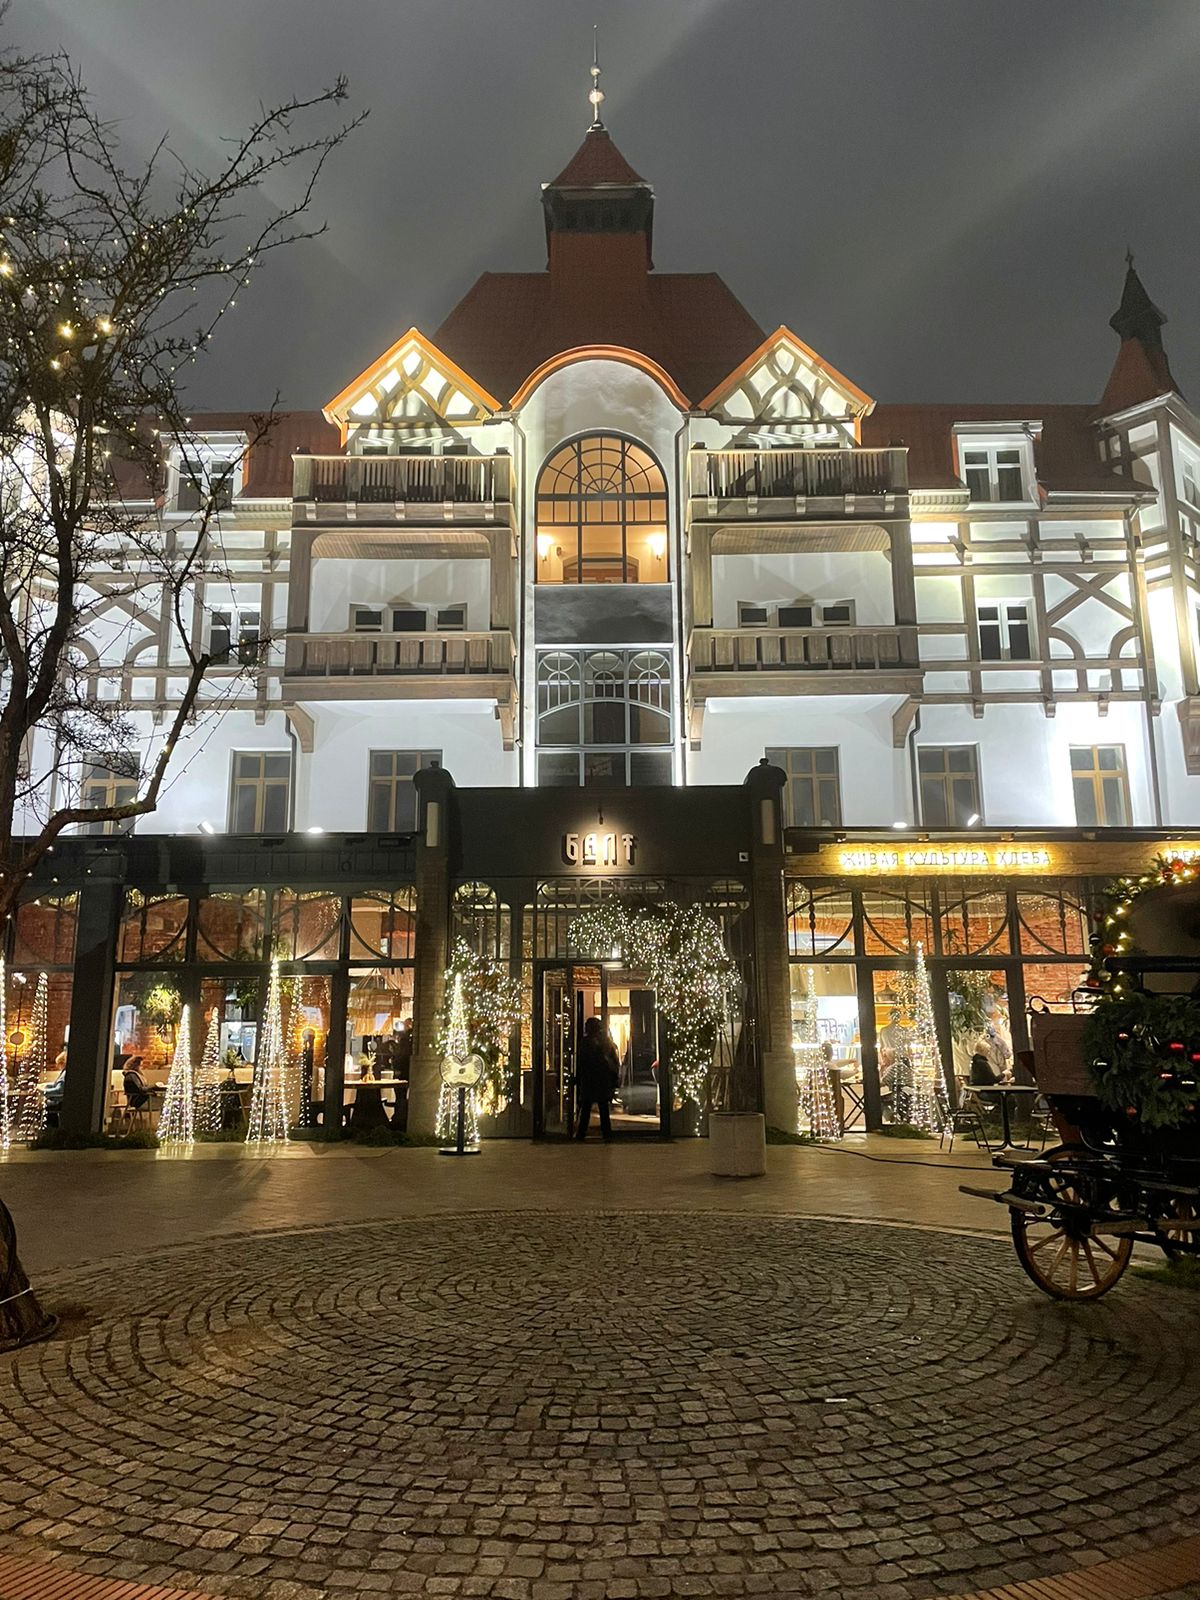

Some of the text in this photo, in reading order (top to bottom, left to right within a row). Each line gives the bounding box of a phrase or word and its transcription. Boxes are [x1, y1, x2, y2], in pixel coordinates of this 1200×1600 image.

[842, 851, 1051, 866] ЖИВАЯ КУЛЬТУРА ХЛЕБА
